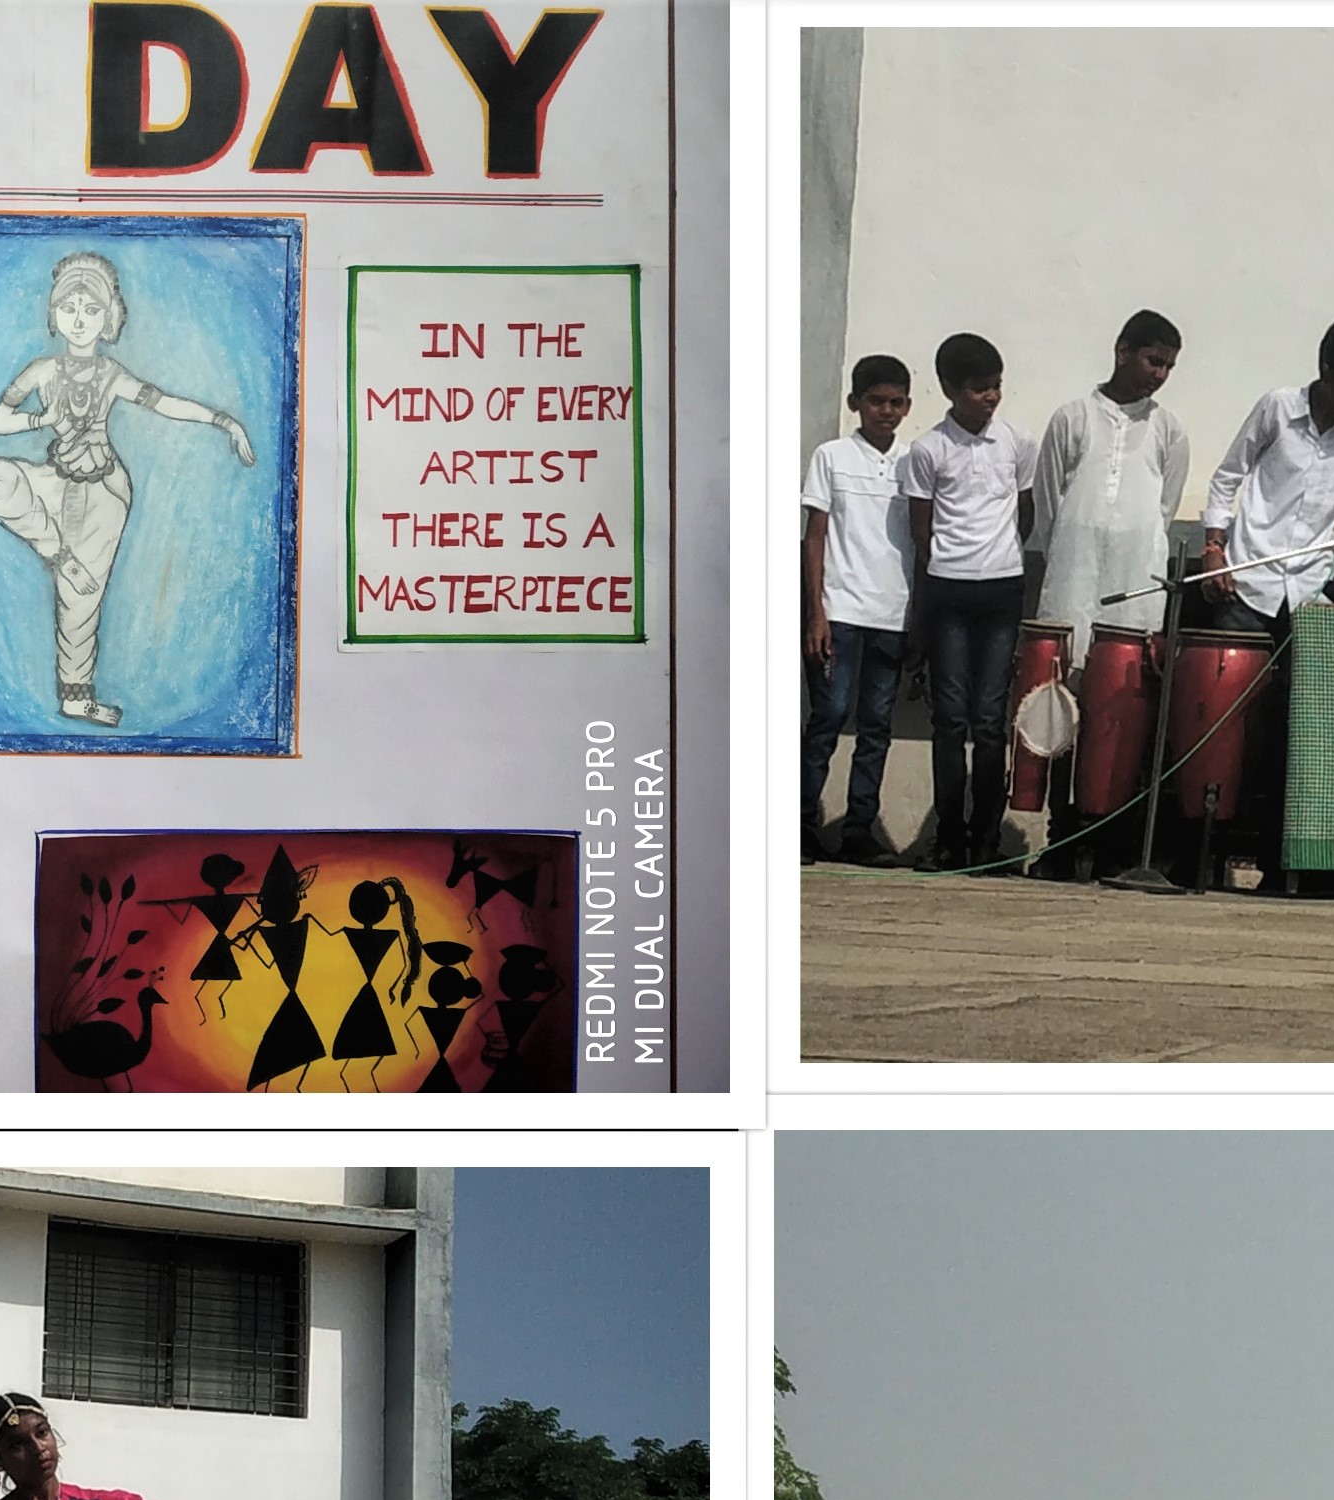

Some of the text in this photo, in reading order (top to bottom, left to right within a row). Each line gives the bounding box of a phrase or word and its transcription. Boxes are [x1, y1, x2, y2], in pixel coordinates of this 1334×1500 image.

[84, 0, 603, 179] DAY
[421, 323, 583, 358] IN THE
[367, 385, 633, 422] MIND OF EVERY
[421, 450, 597, 483] ARTIST
[382, 512, 615, 548] THERE IS A
[358, 575, 630, 613] MASTERPIECE
